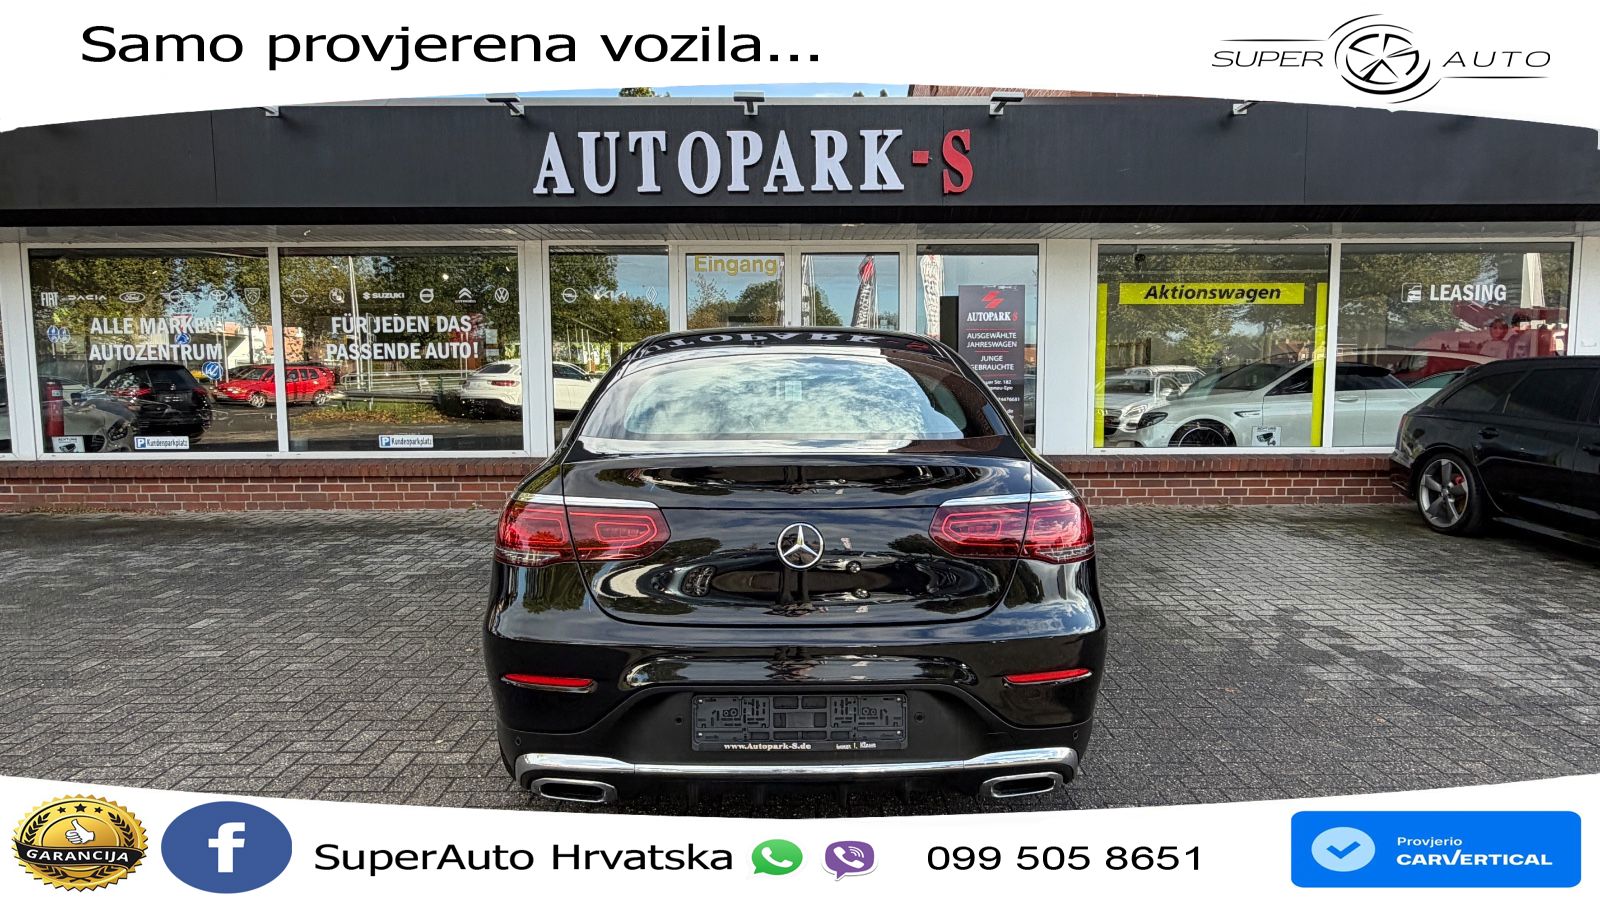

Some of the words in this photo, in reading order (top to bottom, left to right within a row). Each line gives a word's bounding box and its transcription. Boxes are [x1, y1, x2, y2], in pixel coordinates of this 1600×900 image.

[694, 255, 777, 276] Eingang
[41, 292, 58, 307] FIAT
[1144, 285, 1281, 303] Aktionswagen
[1430, 284, 1507, 301] LEASING
[331, 313, 368, 334] FÜR
[372, 315, 430, 333] JEDEN
[436, 315, 472, 333] DAS
[966, 311, 1011, 321] AUTOPARK
[90, 317, 134, 335] ALLE
[89, 343, 223, 361] AUTOZENTRUM
[326, 342, 421, 360] PASSENDE
[425, 341, 479, 360] AUTO!
[146, 438, 188, 448] Kundenparkplatz
[391, 437, 432, 447] Kundenparkplatz
[724, 742, 812, 752] www.Autopark-S.de
